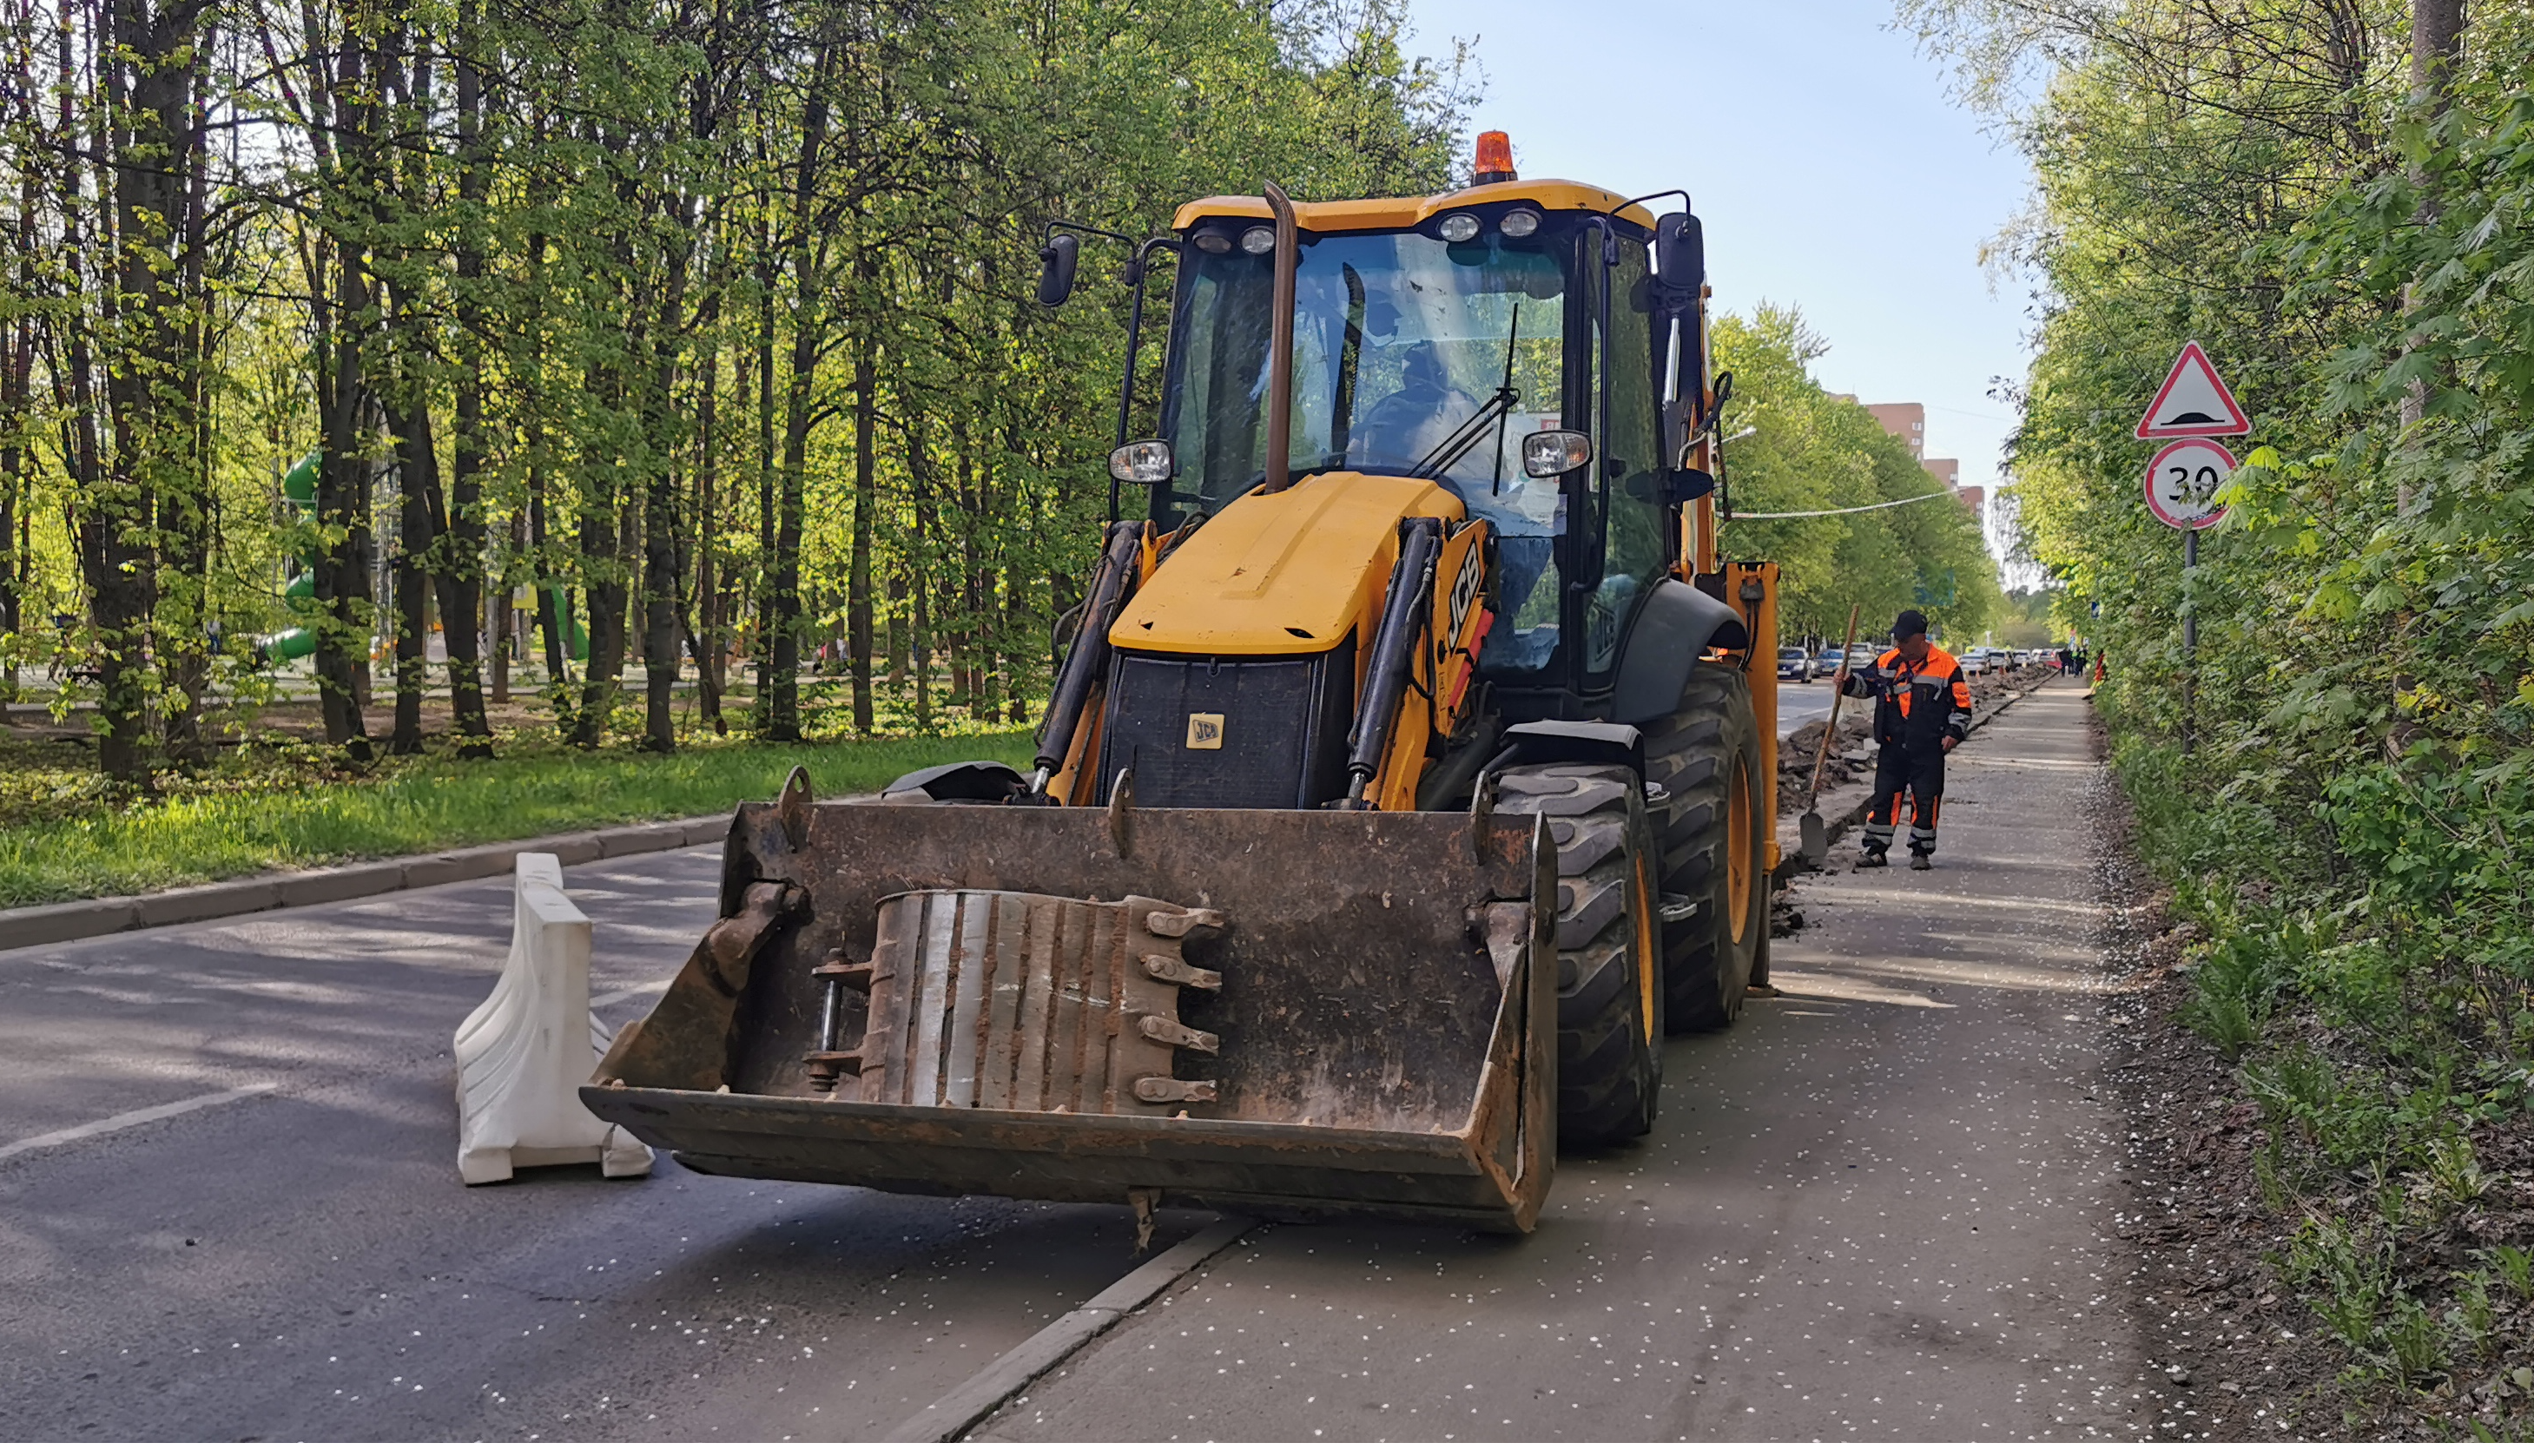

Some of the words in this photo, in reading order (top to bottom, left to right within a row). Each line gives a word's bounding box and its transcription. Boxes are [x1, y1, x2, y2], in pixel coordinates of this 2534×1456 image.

[2168, 466, 2219, 501] 30
[1448, 542, 1480, 649] JCB
[1196, 721, 1218, 740] JCB
